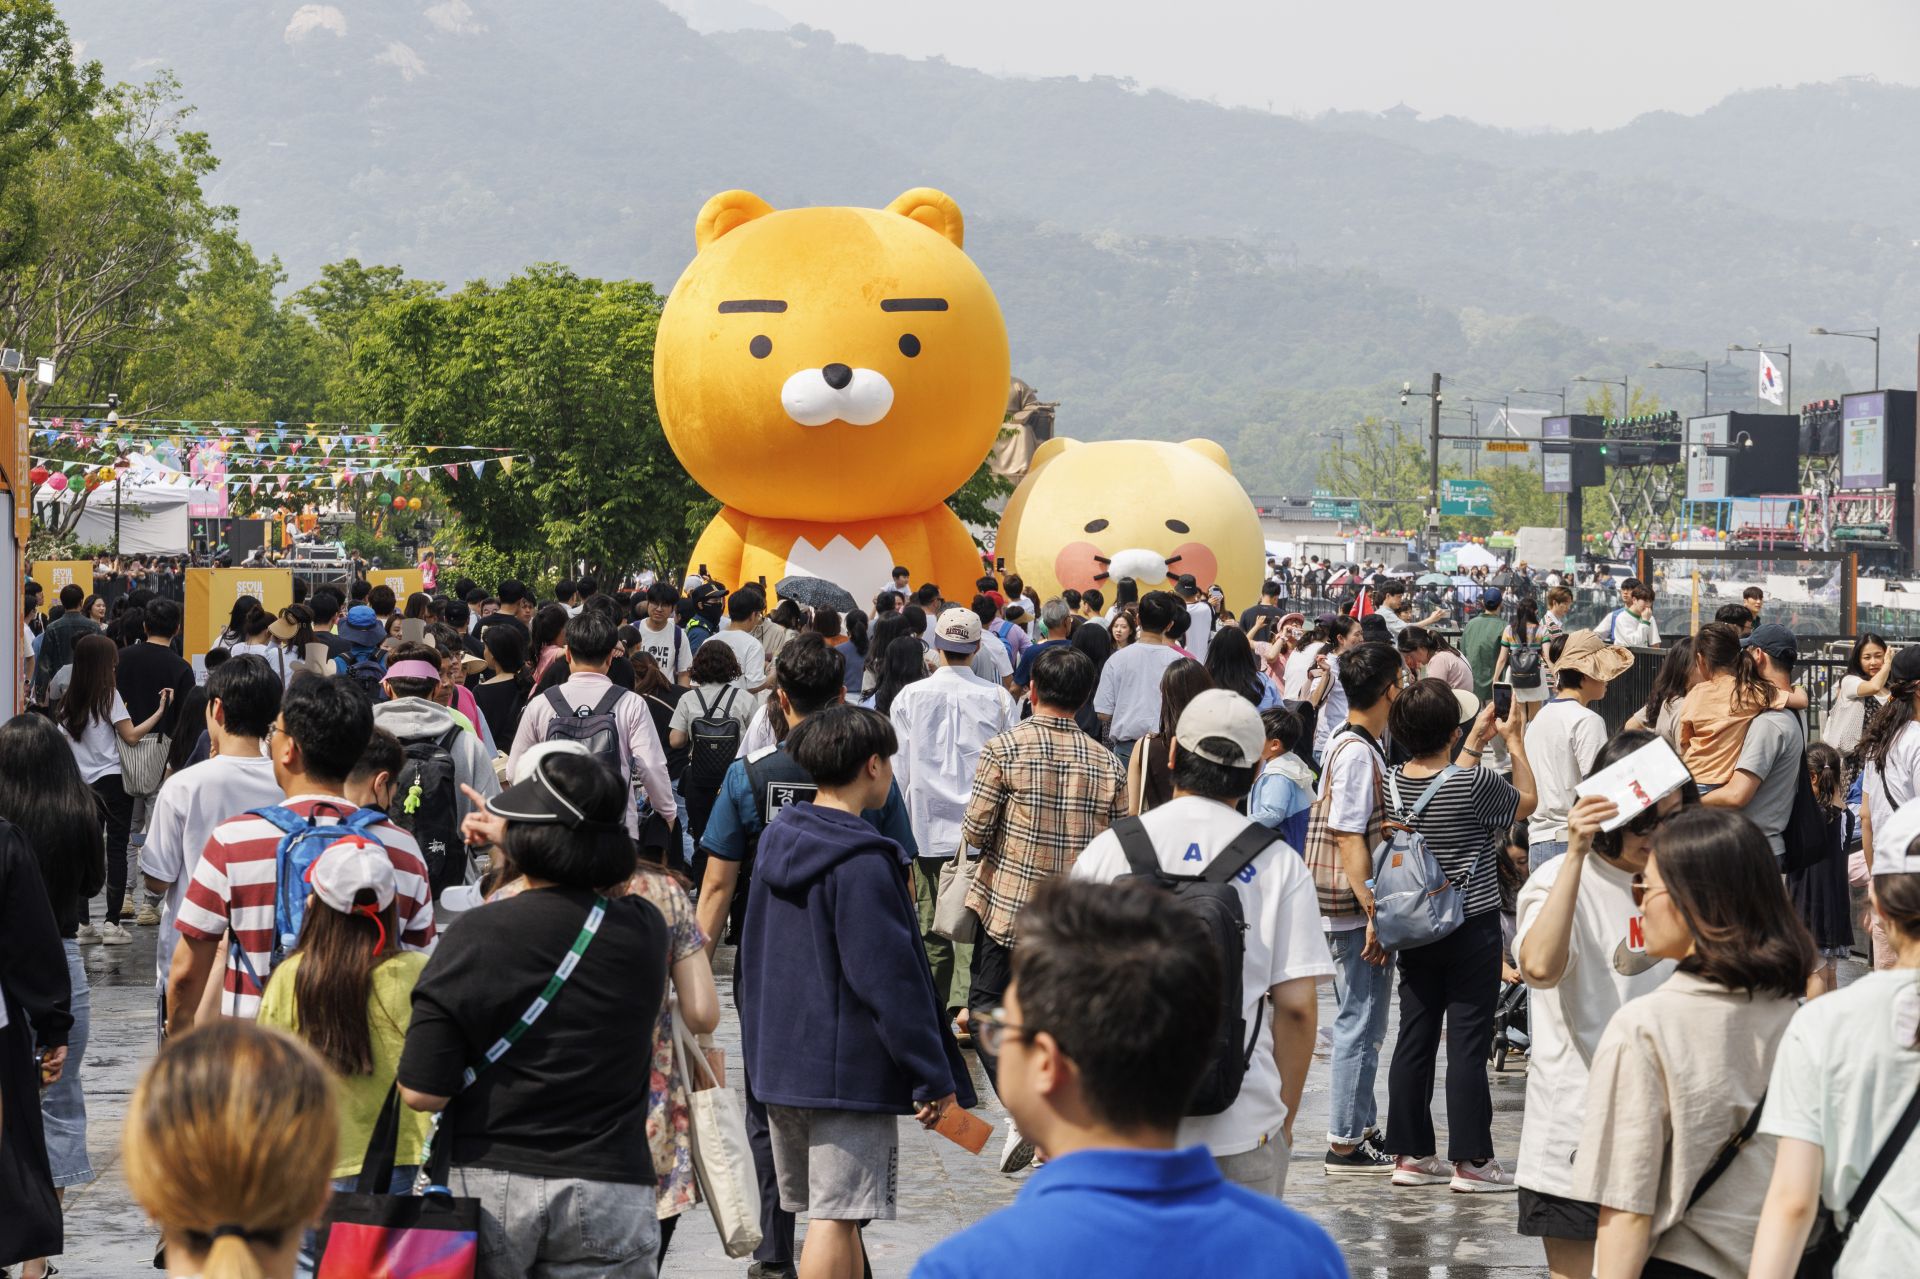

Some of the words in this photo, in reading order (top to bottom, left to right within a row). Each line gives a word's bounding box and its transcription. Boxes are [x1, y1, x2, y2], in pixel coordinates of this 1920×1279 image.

[236, 581, 264, 593] SEOUL
[1183, 843, 1202, 862] A
[1236, 863, 1257, 884] B
